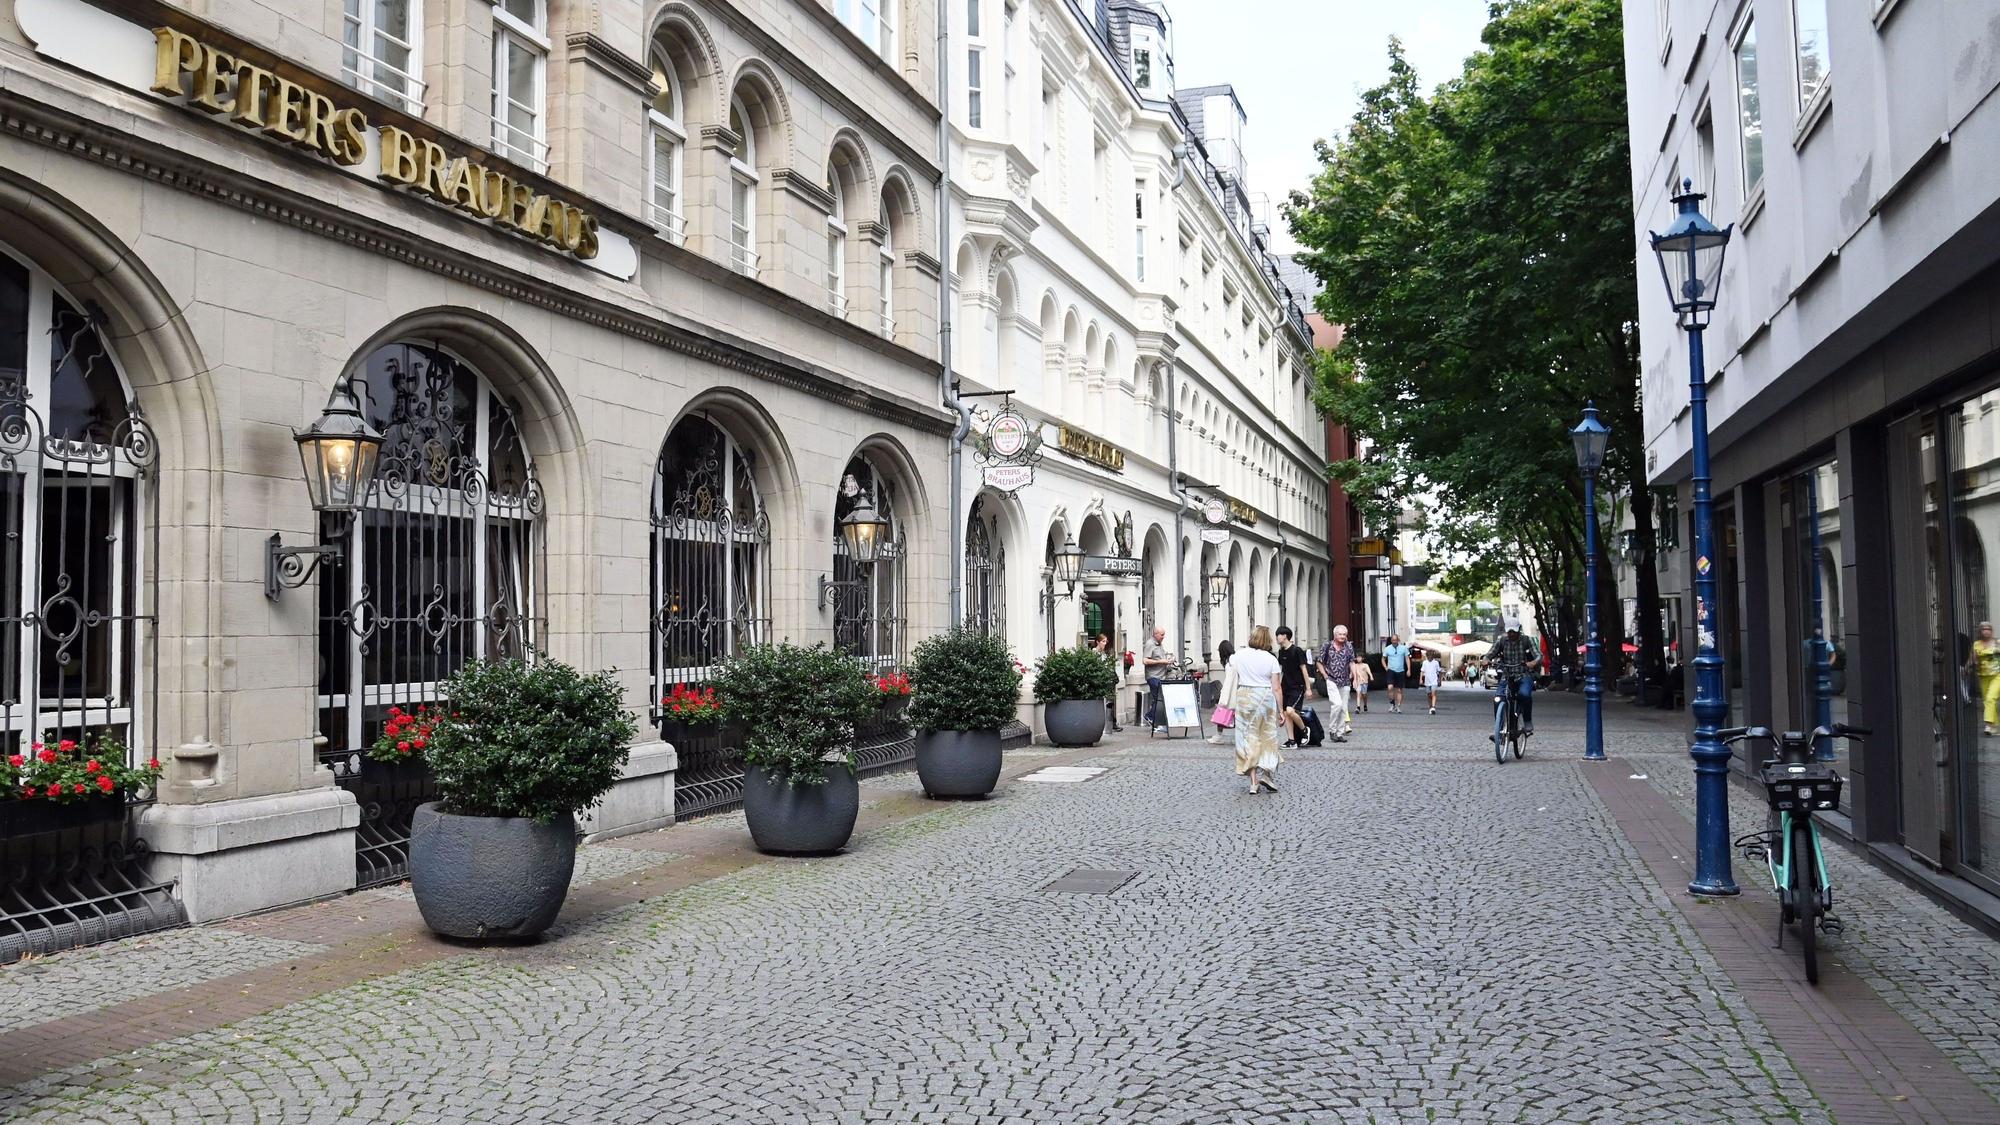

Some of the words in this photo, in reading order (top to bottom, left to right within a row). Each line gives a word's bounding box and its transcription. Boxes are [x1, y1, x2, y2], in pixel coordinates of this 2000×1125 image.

[150, 26, 368, 166] PETERS
[377, 125, 600, 260] BRAUHAUS
[987, 472, 1030, 486] BRAUHAUS
[1104, 558, 1137, 571] PETERS
